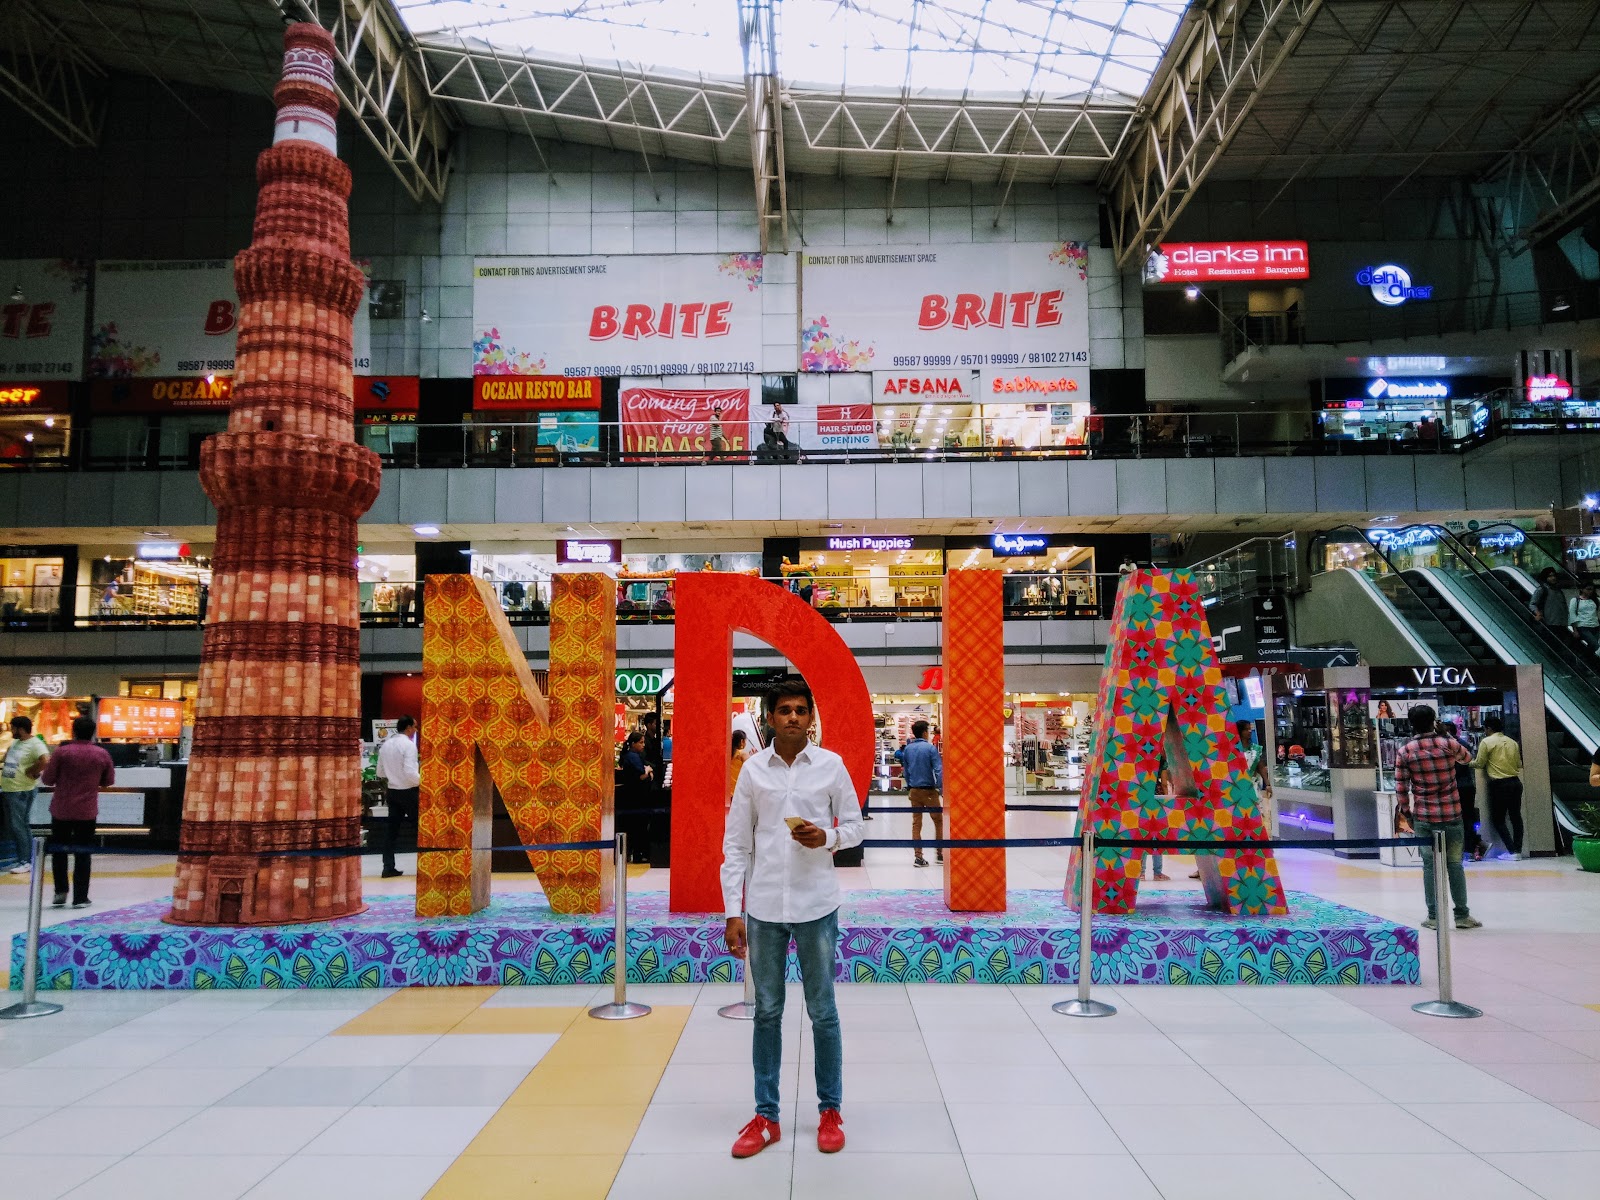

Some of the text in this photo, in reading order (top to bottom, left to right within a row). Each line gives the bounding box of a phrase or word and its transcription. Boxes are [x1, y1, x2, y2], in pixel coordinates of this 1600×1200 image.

[809, 253, 937, 265] CONTACT FOR THIS ADVERTISEMENT SPACE
[1173, 244, 1304, 263] clarks inn
[479, 265, 607, 277] CONTACT FOR THIS ADVERTISEMENT SPACE
[1208, 268, 1256, 276] Restaurant
[1265, 266, 1306, 274] Banquets
[1357, 266, 1398, 285] delhi
[1388, 279, 1433, 297] diner
[917, 289, 1065, 331] BRITE
[588, 300, 733, 342] BRITE
[177, 361, 204, 371] 99587
[206, 360, 235, 370] 99999
[893, 356, 921, 366] 99587
[923, 355, 951, 366] 99999
[960, 355, 988, 365] 95701
[991, 353, 1019, 364] 99999
[1028, 353, 1057, 363] 98102
[1059, 351, 1087, 362] 27143
[564, 366, 591, 377] 99587
[593, 365, 621, 376] 99999
[631, 364, 658, 375] 95701
[660, 364, 688, 374] 99999
[697, 363, 725, 373] 98102
[727, 362, 755, 372] 27143
[152, 382, 222, 400] OCEAN
[481, 380, 592, 400] OCEAN RESTO BAR
[883, 378, 962, 394] AFSANA
[992, 375, 1078, 396] Sabhyata
[627, 392, 745, 420] Coming Soon
[391, 414, 416, 422] BAR
[662, 418, 708, 435] Here
[841, 424, 872, 432] STUDIO
[822, 436, 870, 444] OPENING
[829, 538, 912, 550] Hush Puppies
[1263, 626, 1277, 634] JBL
[1284, 674, 1308, 690] VEGA
[1412, 667, 1475, 685] VEGA
